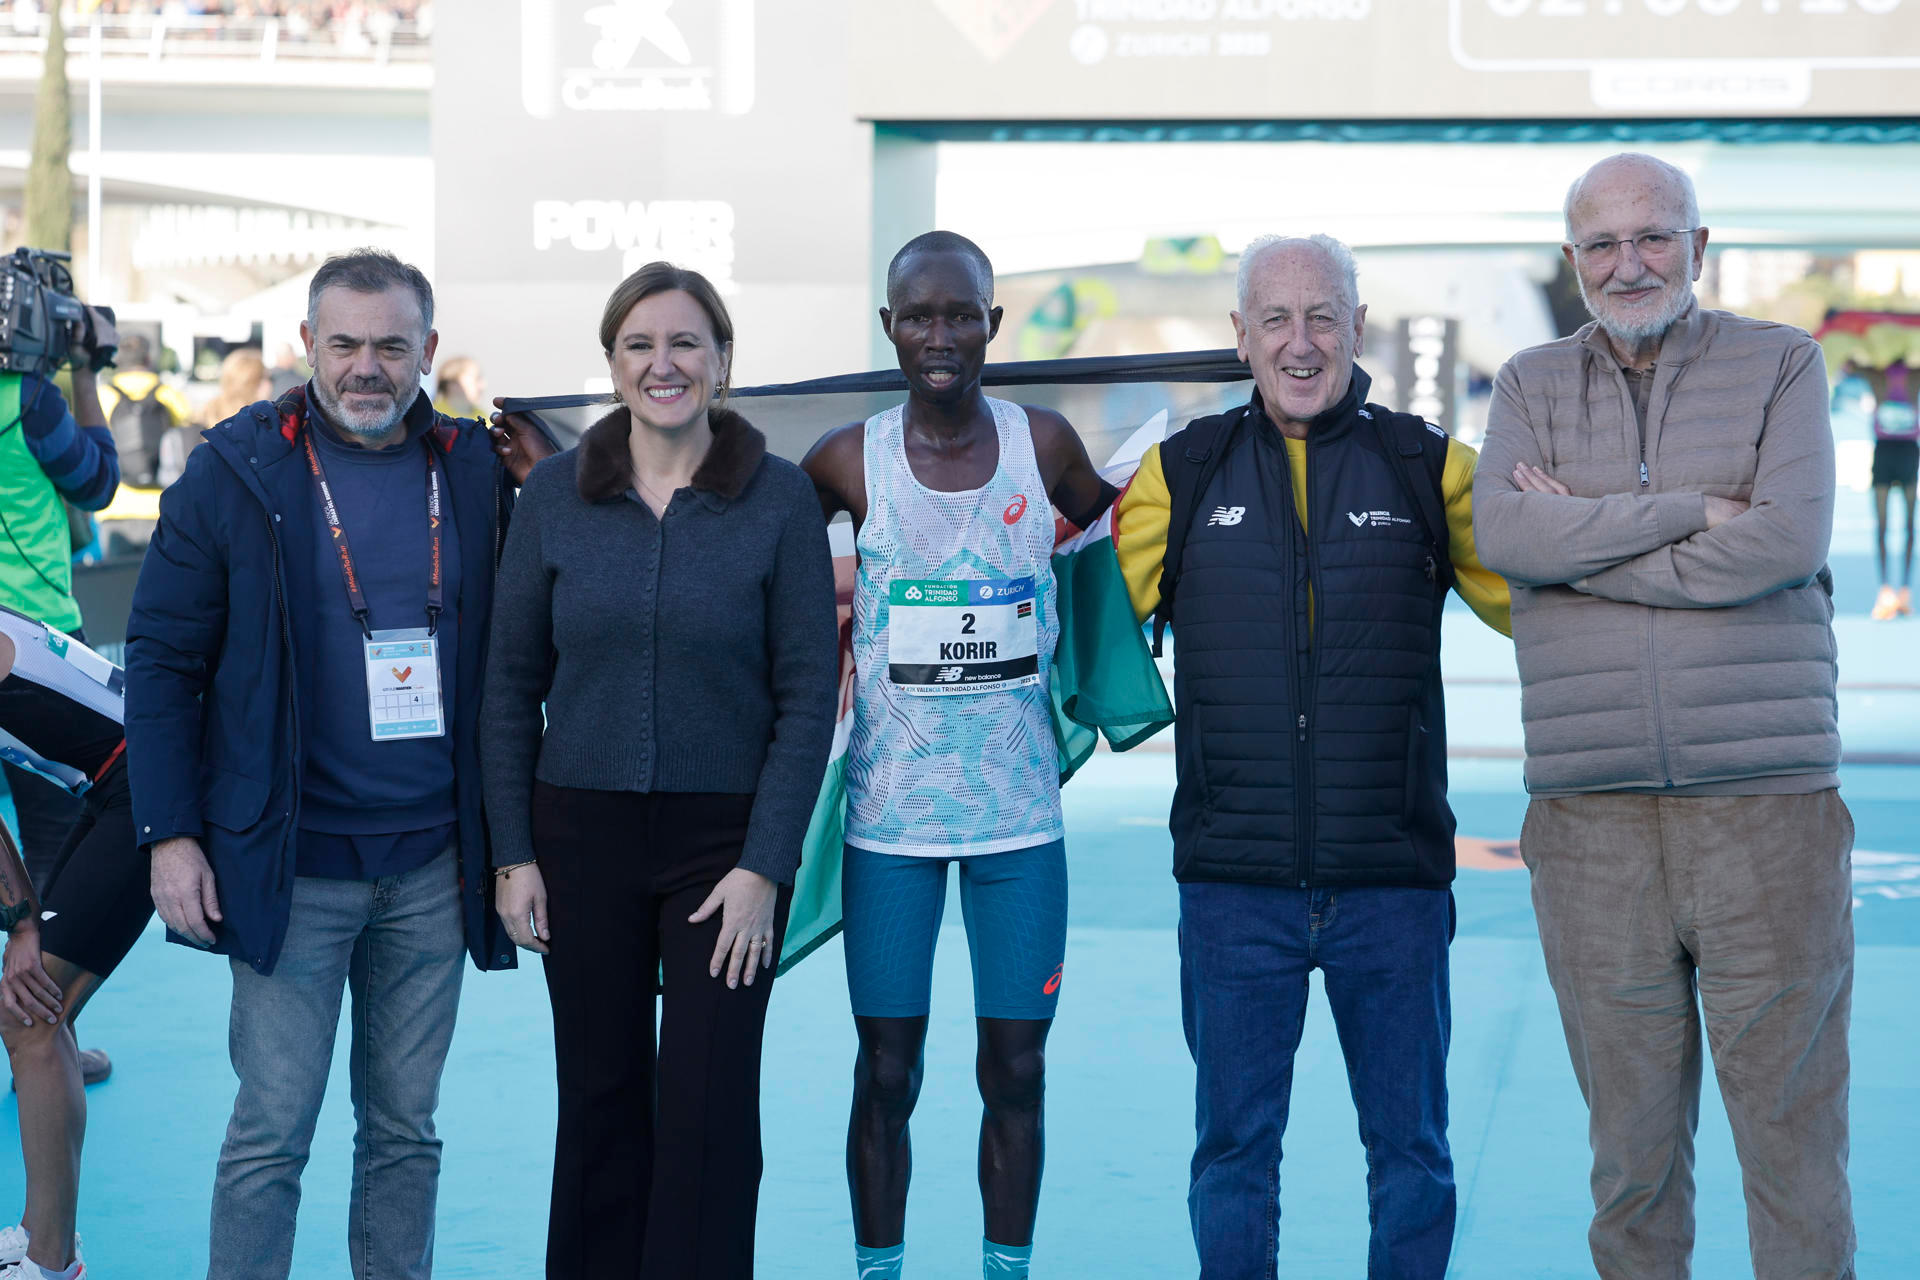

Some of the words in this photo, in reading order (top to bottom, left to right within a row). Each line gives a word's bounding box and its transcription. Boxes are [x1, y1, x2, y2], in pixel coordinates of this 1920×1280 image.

[533, 199, 735, 251] POWER
[997, 585, 1024, 595] ZURICH
[961, 613, 976, 634] 2
[940, 641, 997, 660] KORIR
[942, 685, 972, 693] TRINIDAD
[972, 683, 1001, 691] ALFONSO
